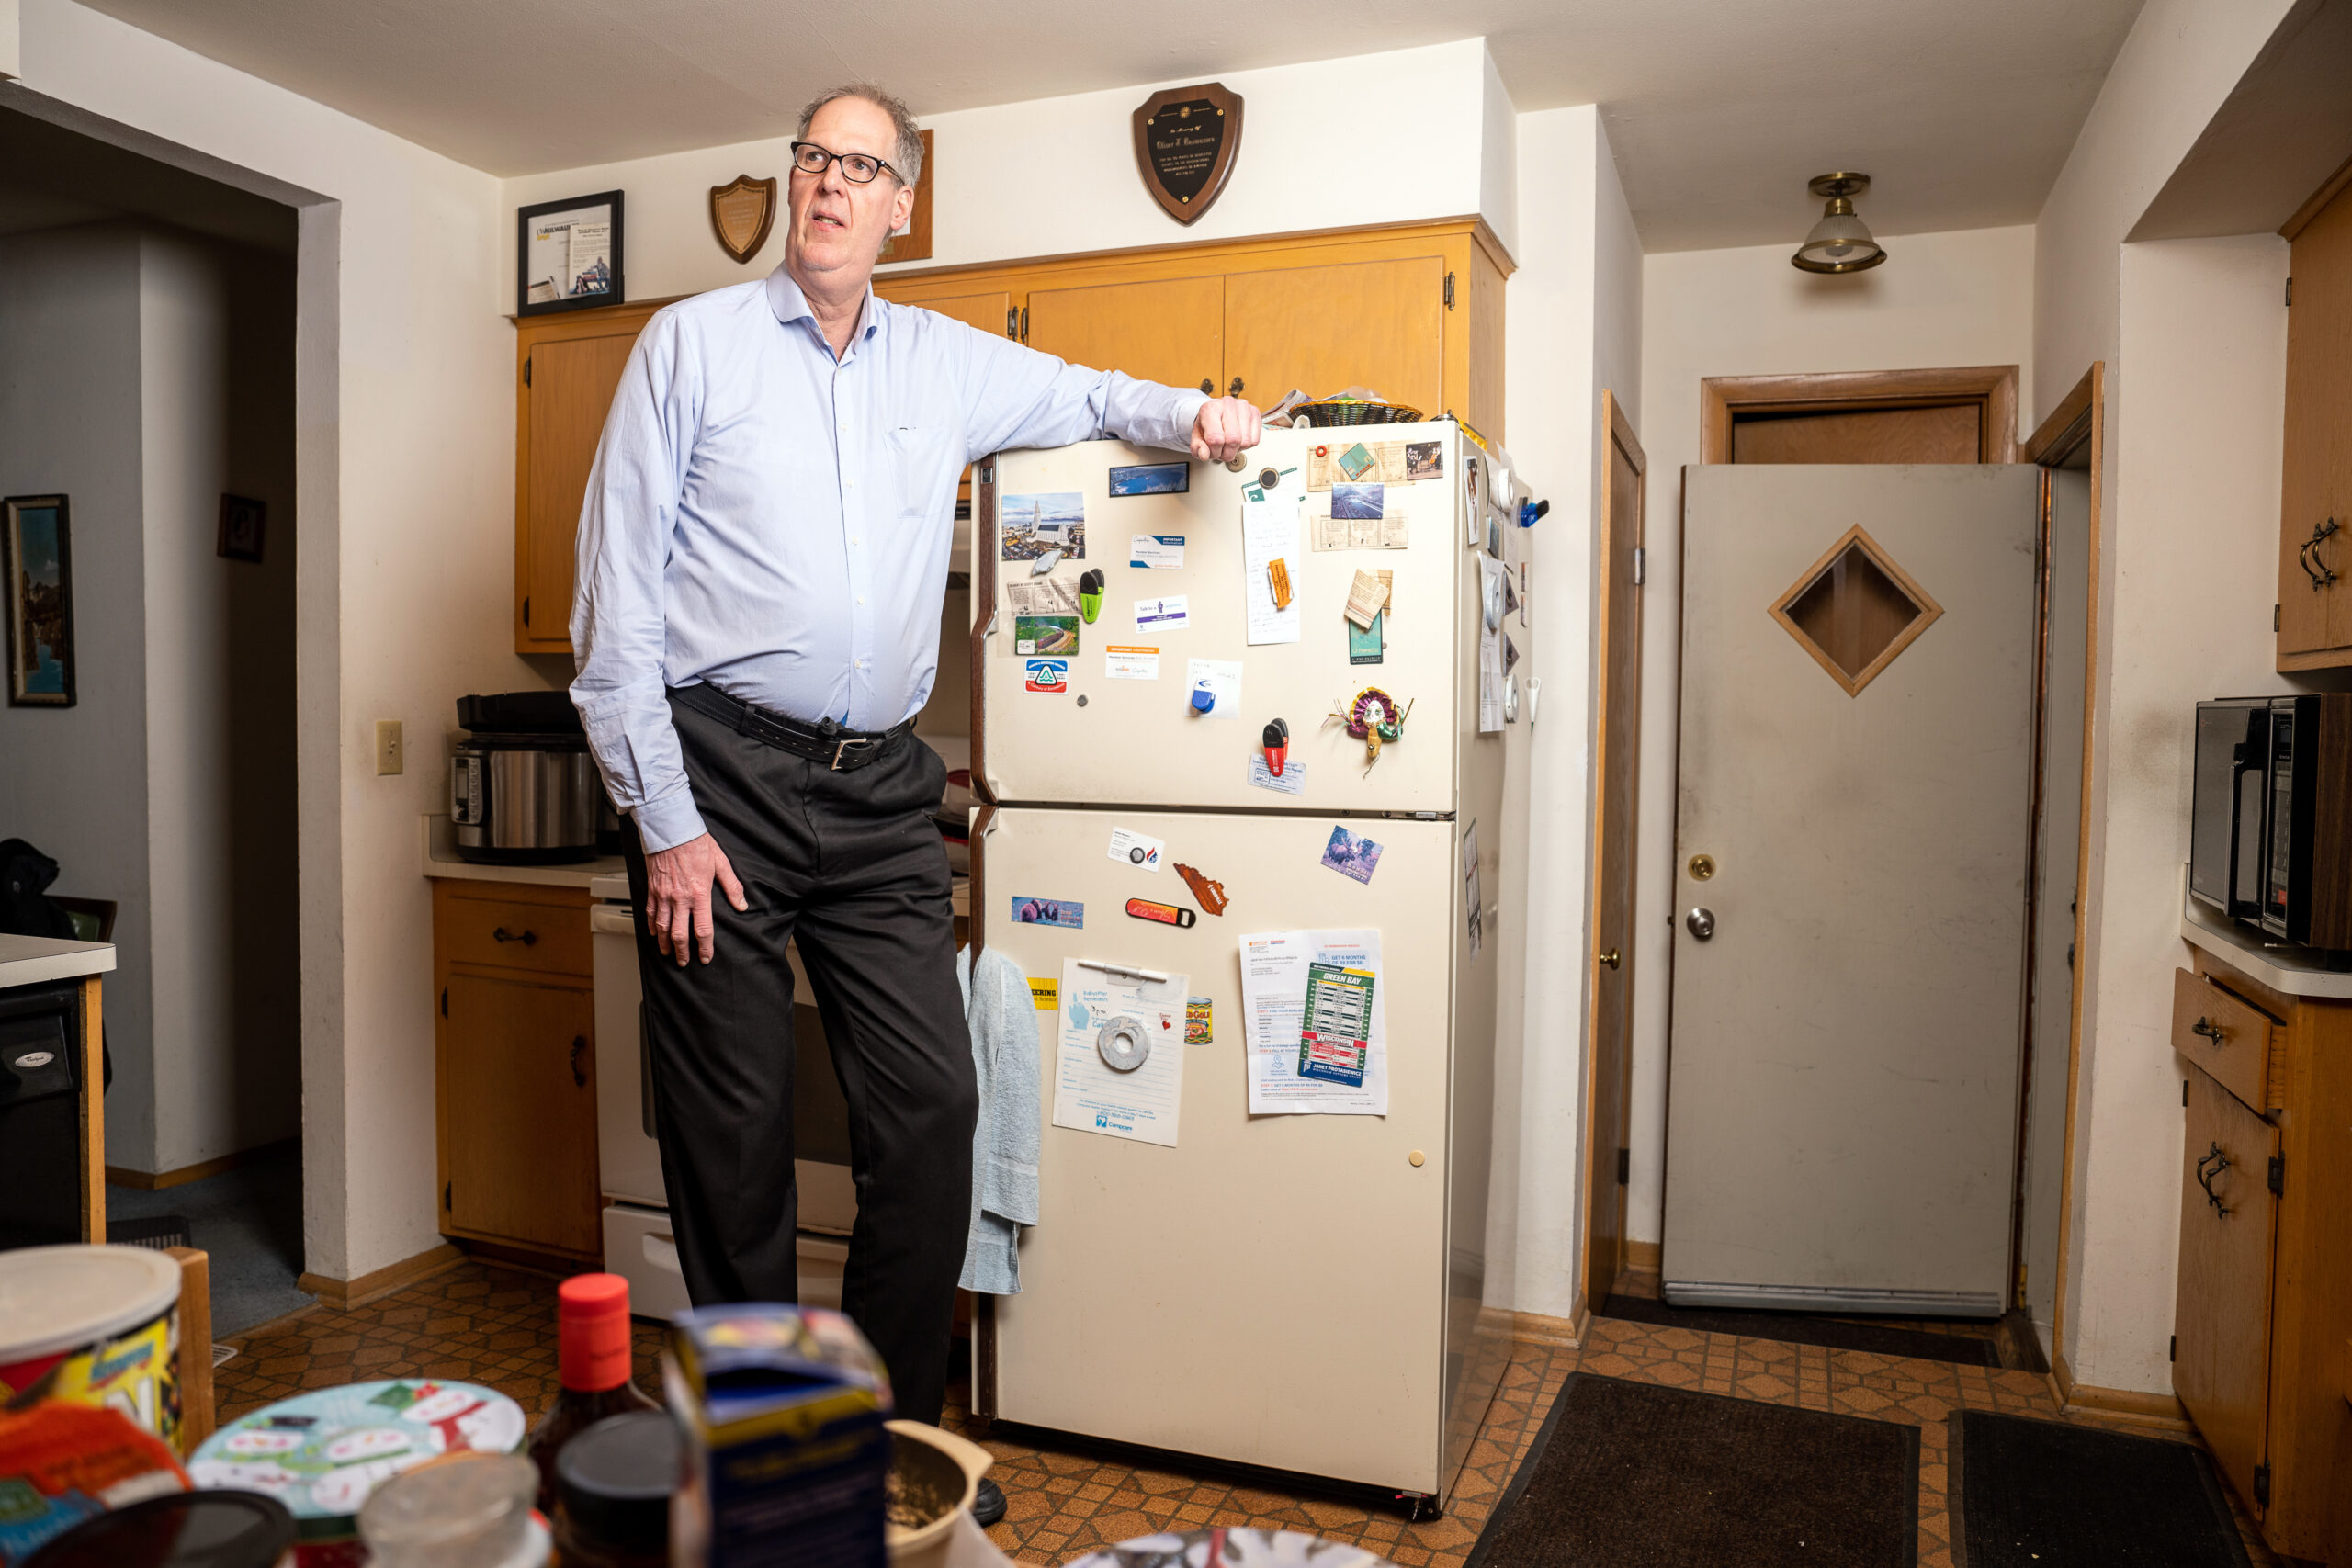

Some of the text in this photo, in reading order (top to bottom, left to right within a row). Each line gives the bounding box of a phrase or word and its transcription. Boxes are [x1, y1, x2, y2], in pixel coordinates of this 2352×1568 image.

[1323, 973, 1362, 985] GREEN BAY
[1031, 988, 1057, 997] EERING
[1317, 1033, 1354, 1047] WISCONSIN
[1328, 1066, 1362, 1077] PROTASIEWICZ
[1108, 1122, 1133, 1131] Compcare
